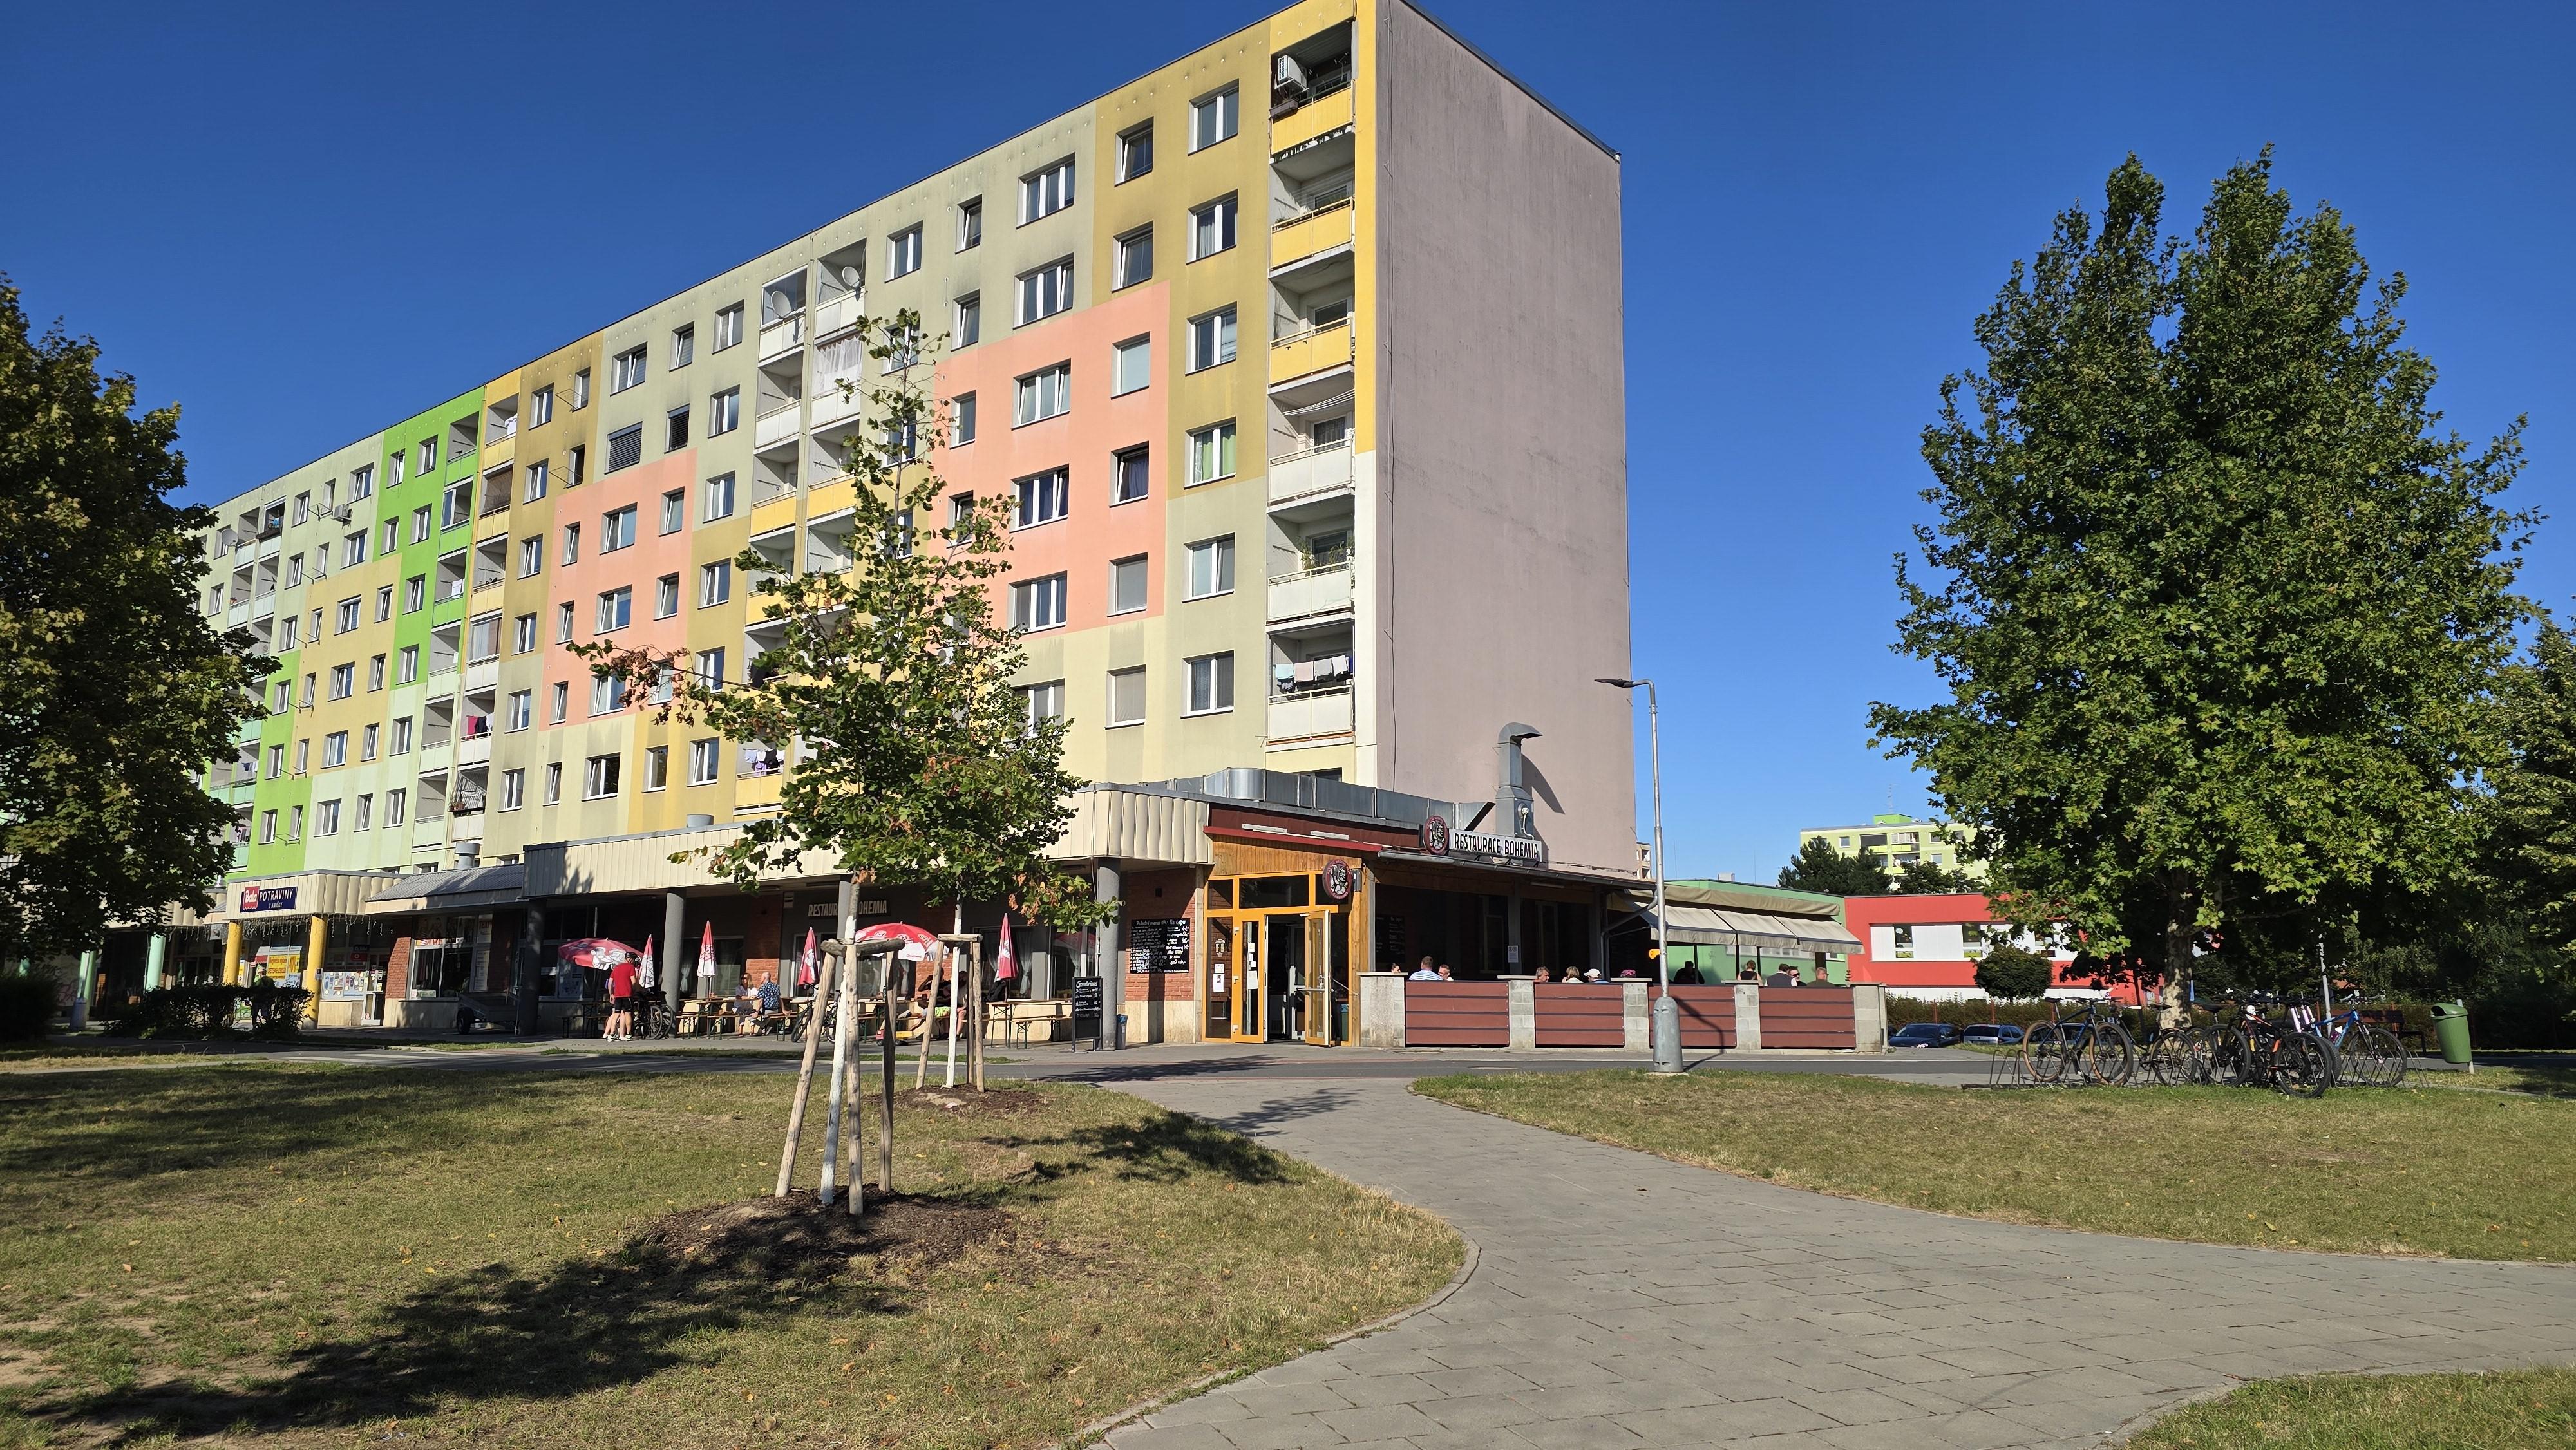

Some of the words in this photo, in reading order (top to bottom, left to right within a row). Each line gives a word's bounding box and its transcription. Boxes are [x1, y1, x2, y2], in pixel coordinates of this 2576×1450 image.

[1454, 833, 1501, 853] RESTAURACE
[1504, 840, 1539, 858] BOHEMIA
[245, 890, 258, 903] Bala
[259, 889, 294, 901] POTRAVINY
[808, 903, 838, 917] RESTAUR
[858, 900, 887, 914] OHEMIA
